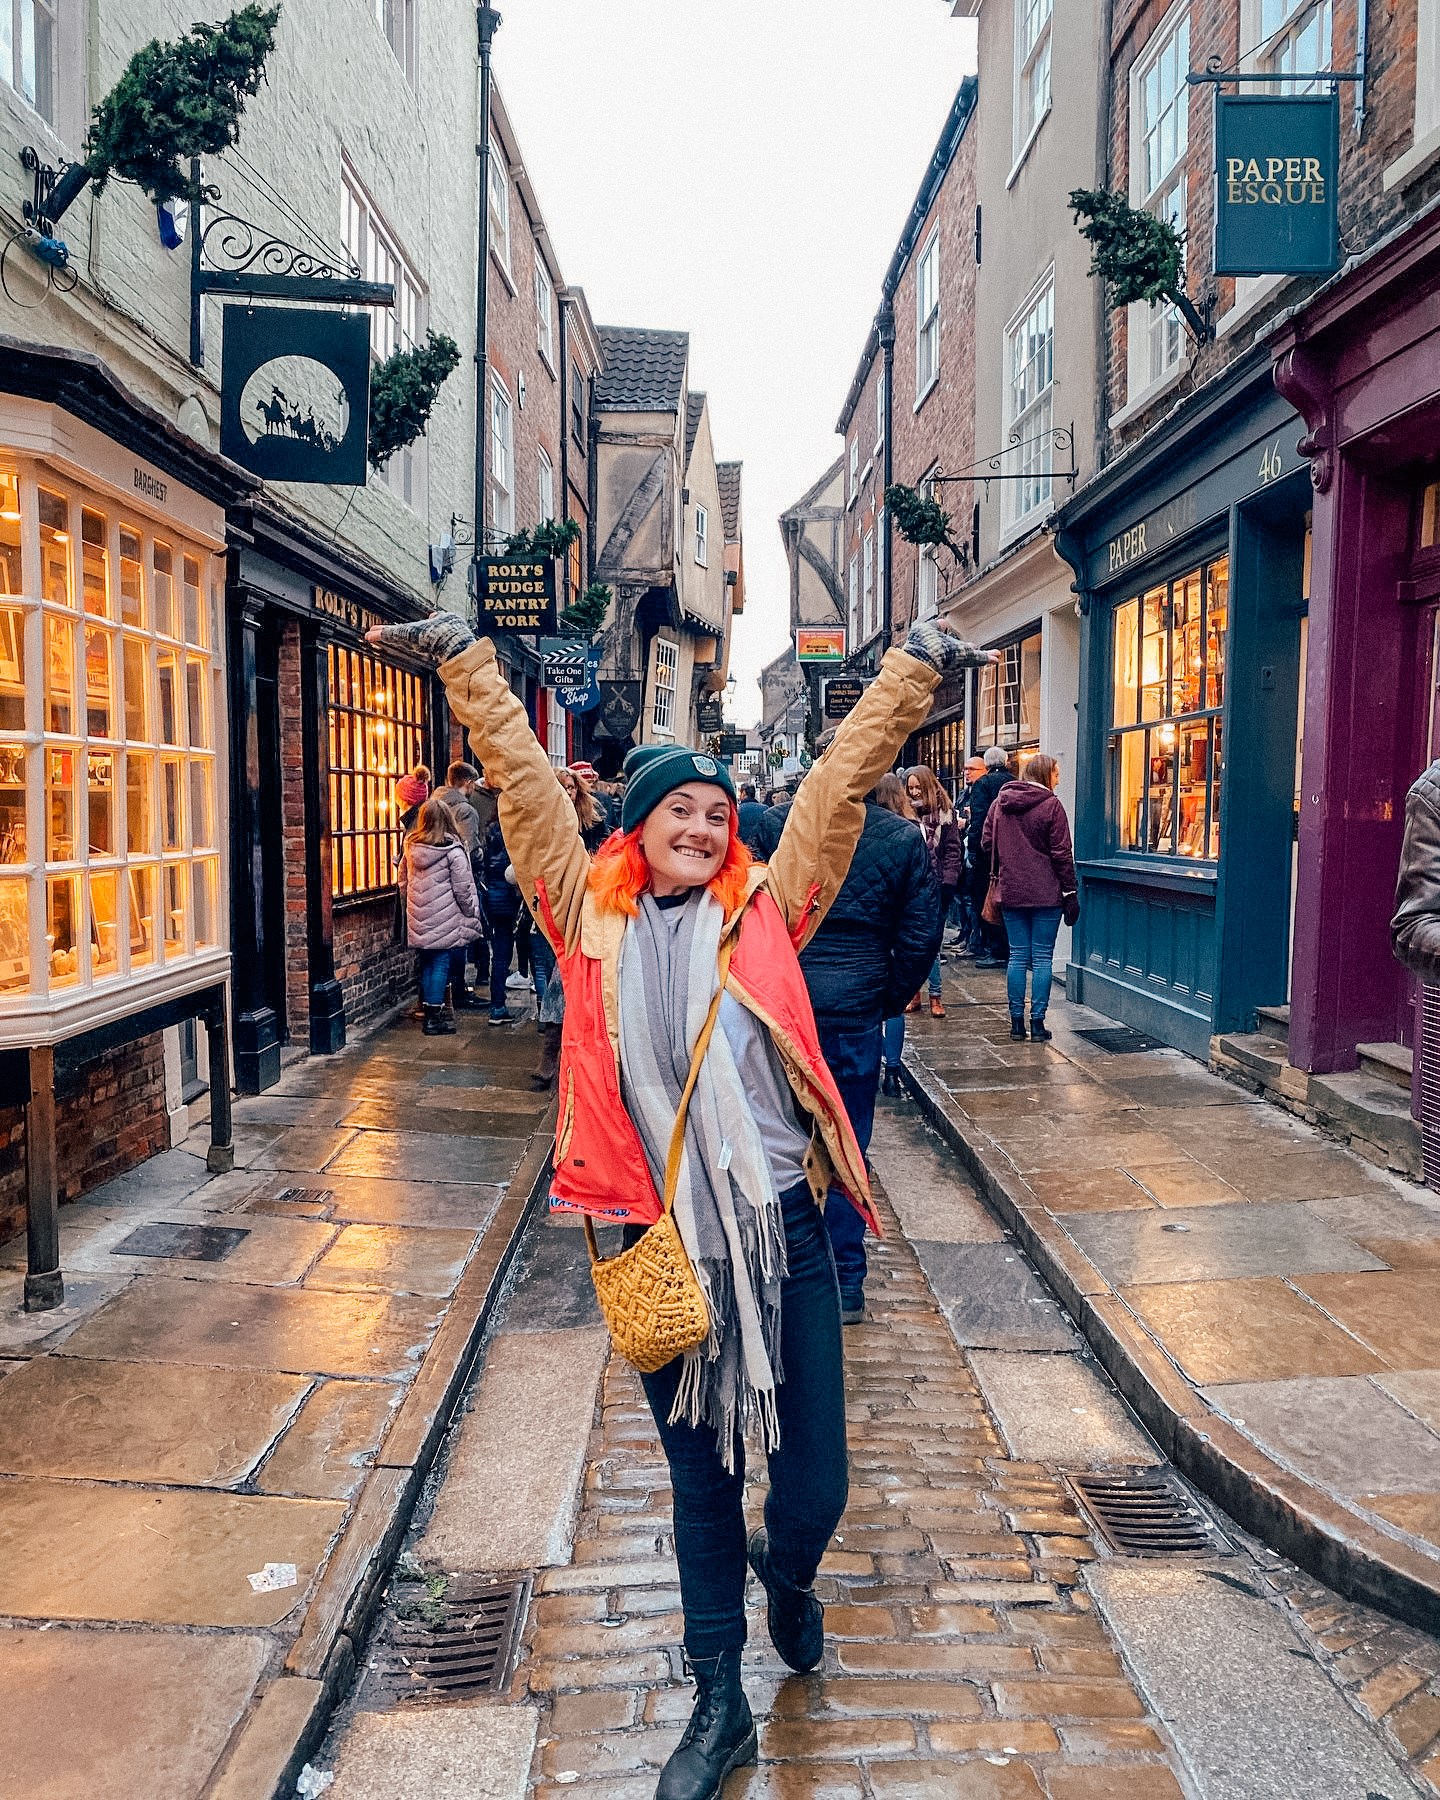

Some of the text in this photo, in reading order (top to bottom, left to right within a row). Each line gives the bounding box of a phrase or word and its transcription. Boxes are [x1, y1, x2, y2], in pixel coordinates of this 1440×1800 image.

[1226, 157, 1325, 182] PAPER
[1226, 182, 1326, 205] ESQUE
[1257, 439, 1282, 485] 46
[1108, 522, 1148, 573] PAPER
[487, 564, 544, 577] ROLY'S
[487, 581, 545, 594] FUDGE
[315, 585, 358, 628] ROLY'S
[483, 598, 550, 611] PANTRY
[494, 615, 541, 627] YORK
[545, 666, 582, 675] Take One
[554, 675, 574, 684] Gifts
[565, 691, 589, 707] Shop
